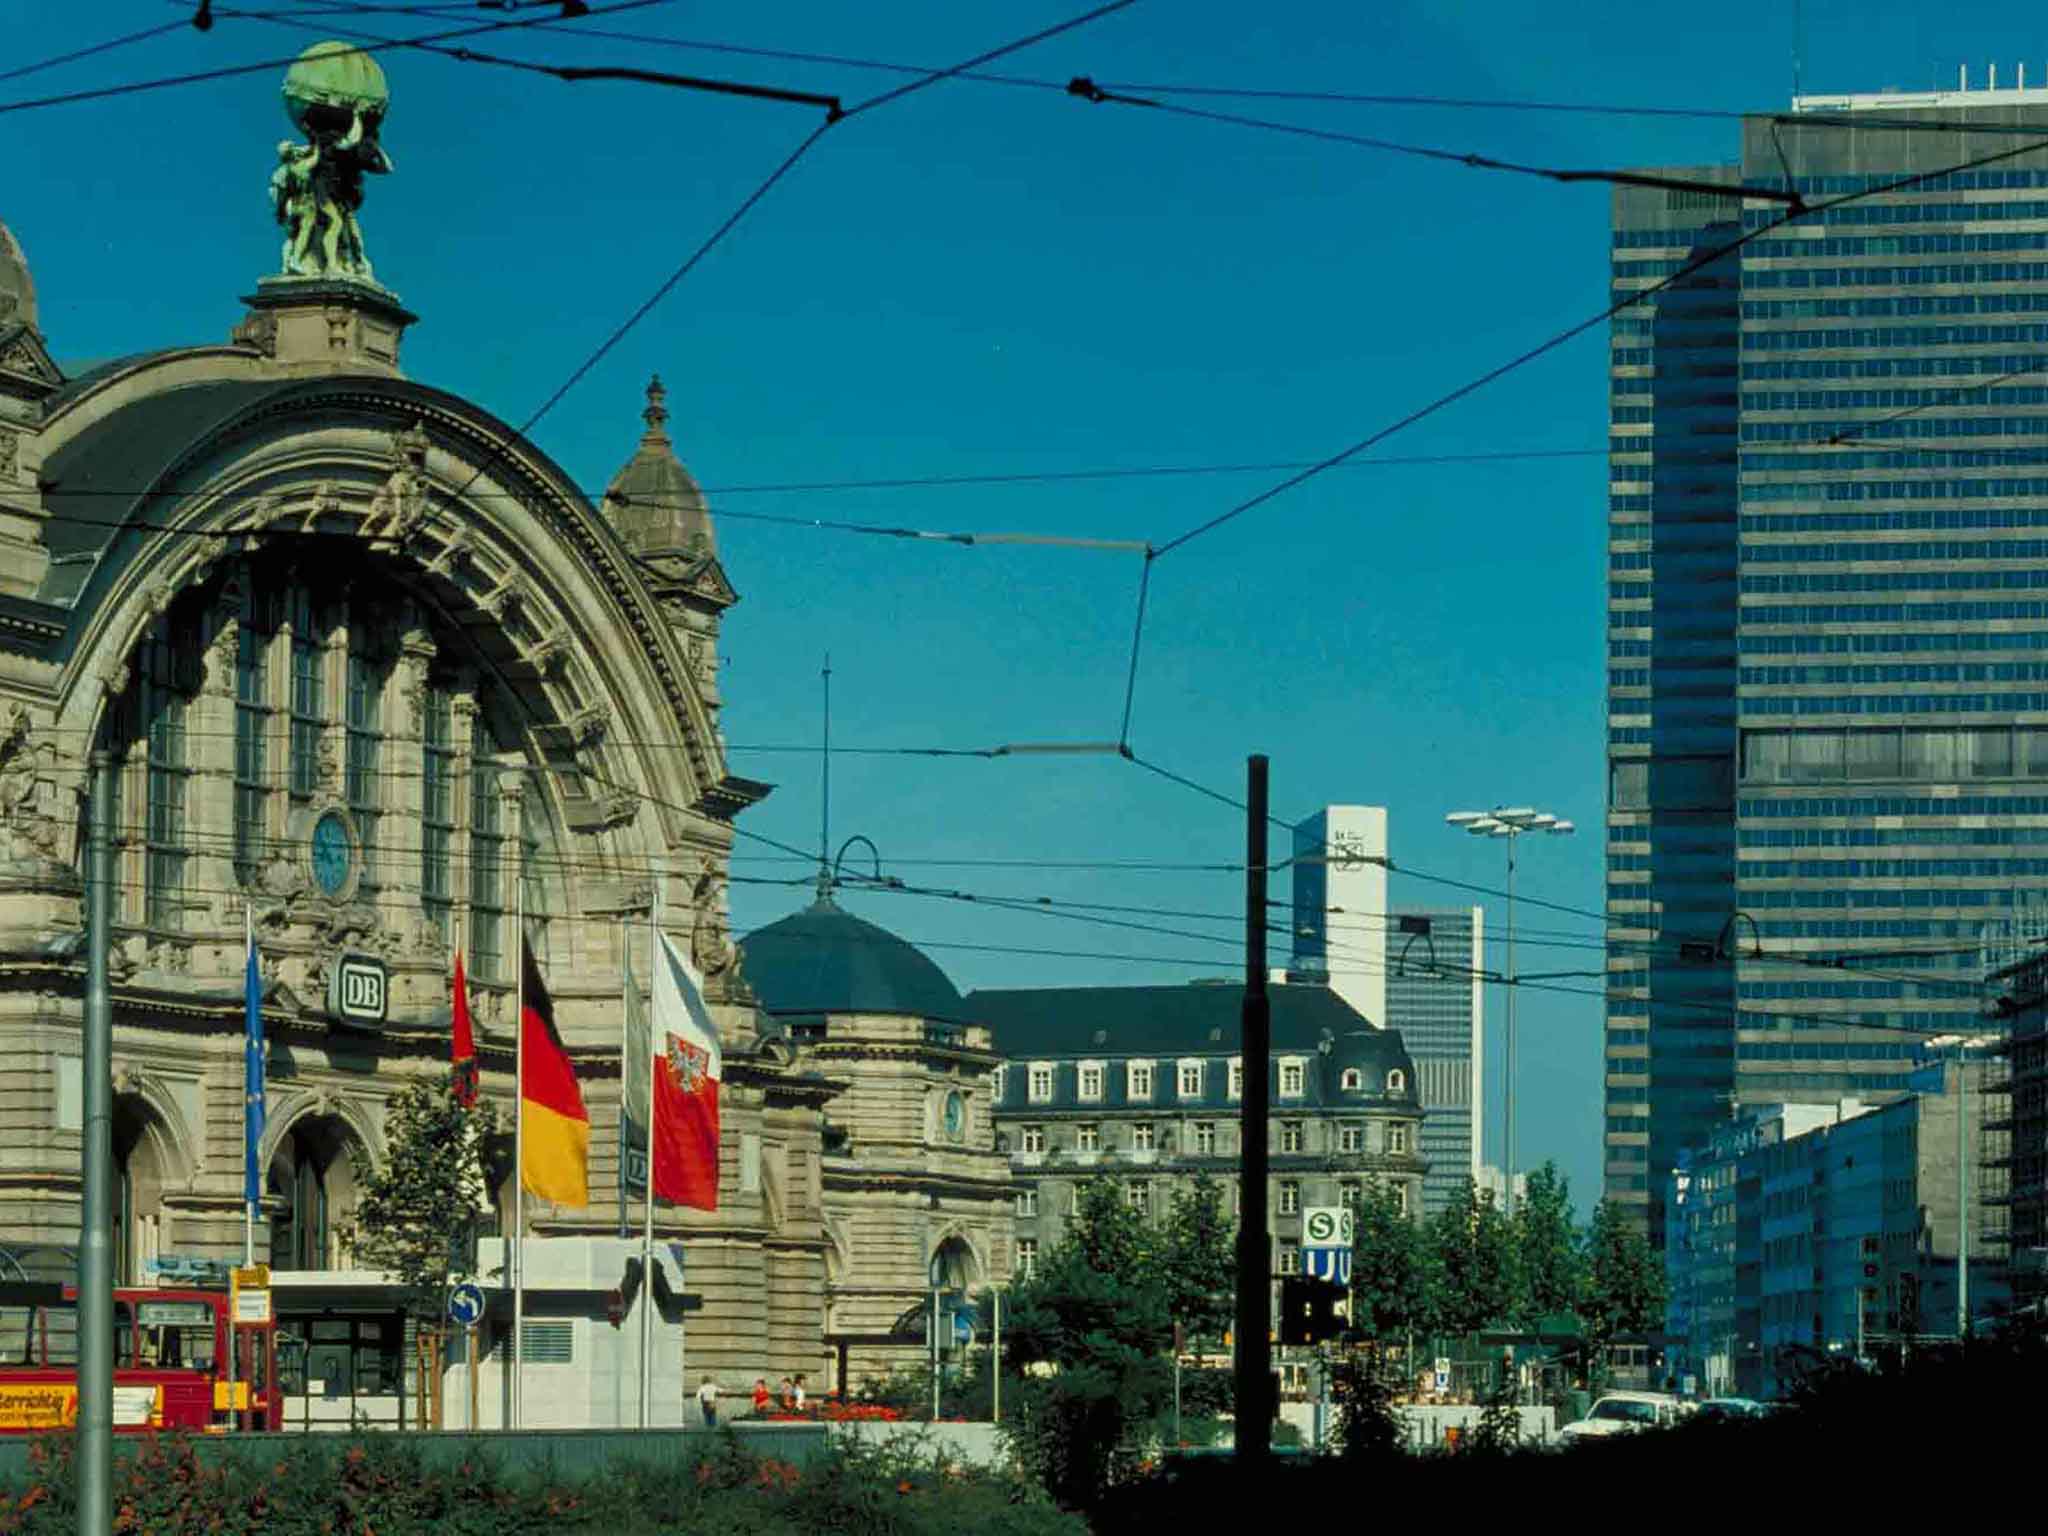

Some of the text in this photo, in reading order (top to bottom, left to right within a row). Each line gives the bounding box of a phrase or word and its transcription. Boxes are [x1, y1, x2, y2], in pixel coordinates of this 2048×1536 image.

[348, 975, 379, 1007] DB
[1310, 1213, 1332, 1239] S
[1307, 1251, 1335, 1281] U
[1339, 1251, 1352, 1284] U
